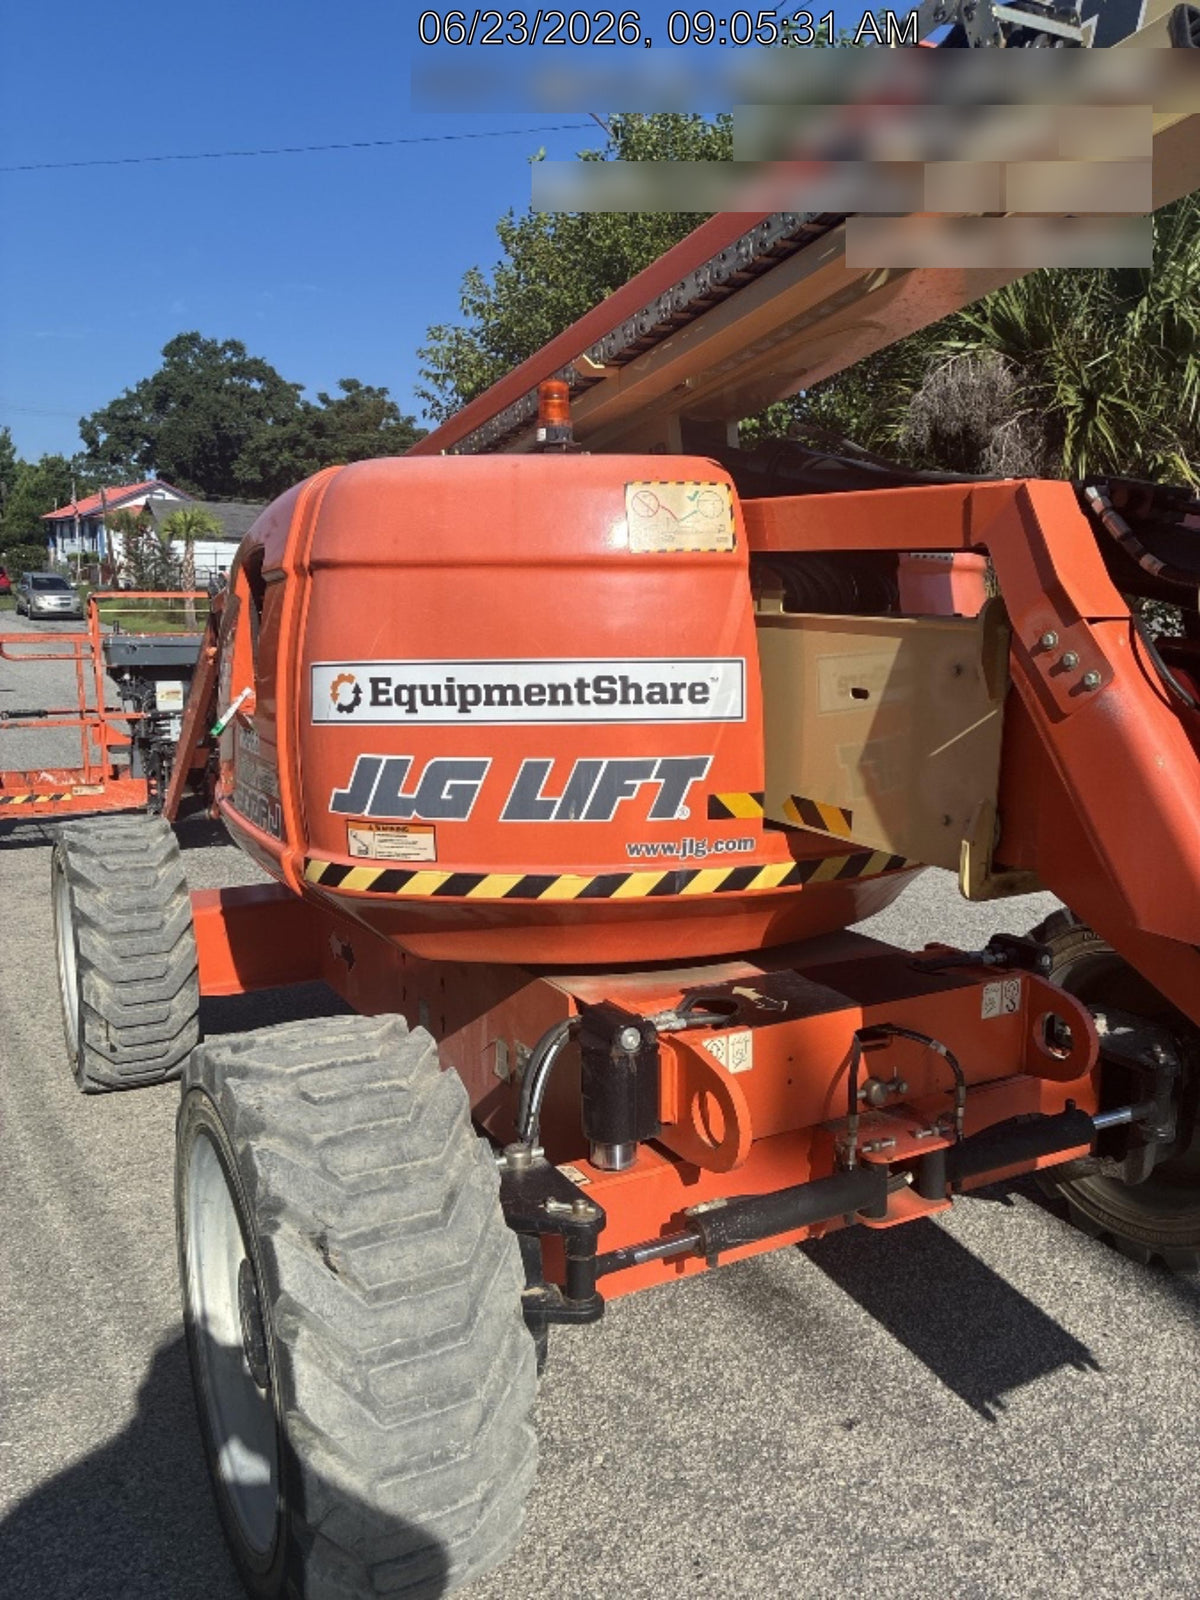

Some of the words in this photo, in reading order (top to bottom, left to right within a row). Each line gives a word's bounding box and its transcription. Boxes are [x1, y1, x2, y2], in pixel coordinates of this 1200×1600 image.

[369, 675, 709, 713] EquipmentShare
[329, 754, 492, 821] JLG
[499, 756, 714, 822] LIFT
[626, 837, 755, 860] www.jlg.com
